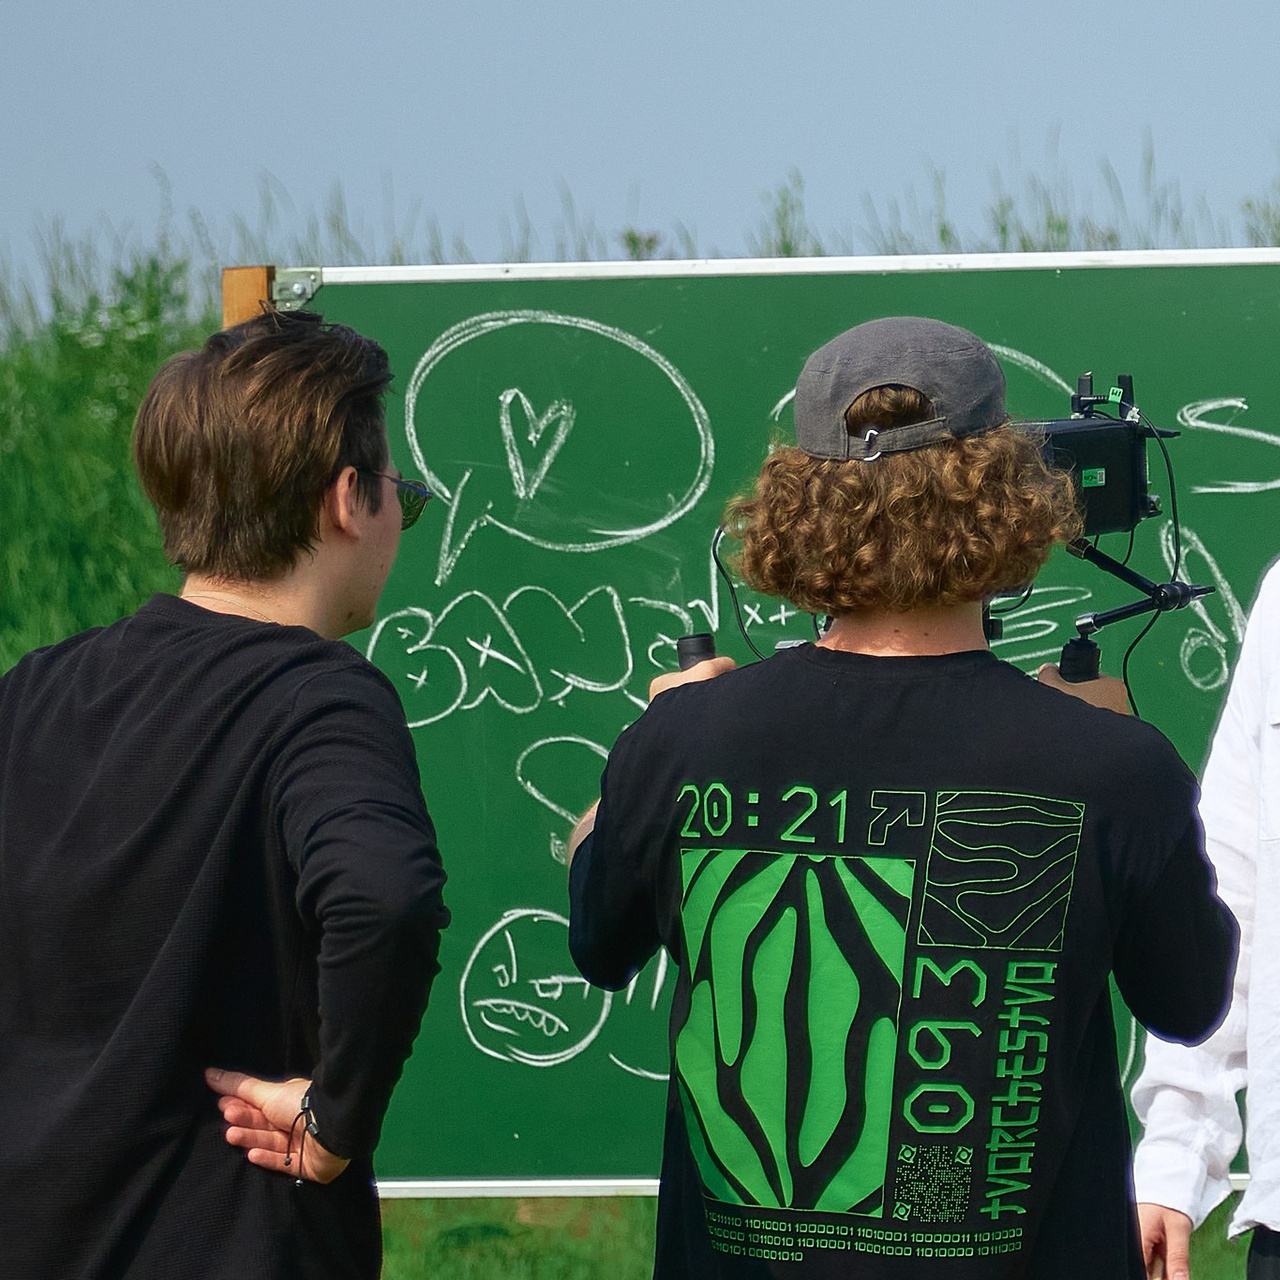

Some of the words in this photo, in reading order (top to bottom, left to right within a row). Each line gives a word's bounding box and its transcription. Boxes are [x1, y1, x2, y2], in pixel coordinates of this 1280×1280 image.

[676, 783, 848, 844] 20:21
[903, 957, 987, 1134] 093
[745, 1219, 792, 1232] 11010001
[795, 1223, 854, 1236] 10000101
[857, 1228, 908, 1242] 11010001
[911, 1233, 970, 1243] 10000011
[974, 1227, 1023, 1242] 11010000
[748, 1233, 794, 1247] 10110010
[797, 1238, 851, 1250] 11010001
[854, 1241, 912, 1256] 10001000
[915, 1247, 974, 1257] 11010000
[977, 1241, 1022, 1256] 10111000
[749, 1247, 804, 1261] 00001010
